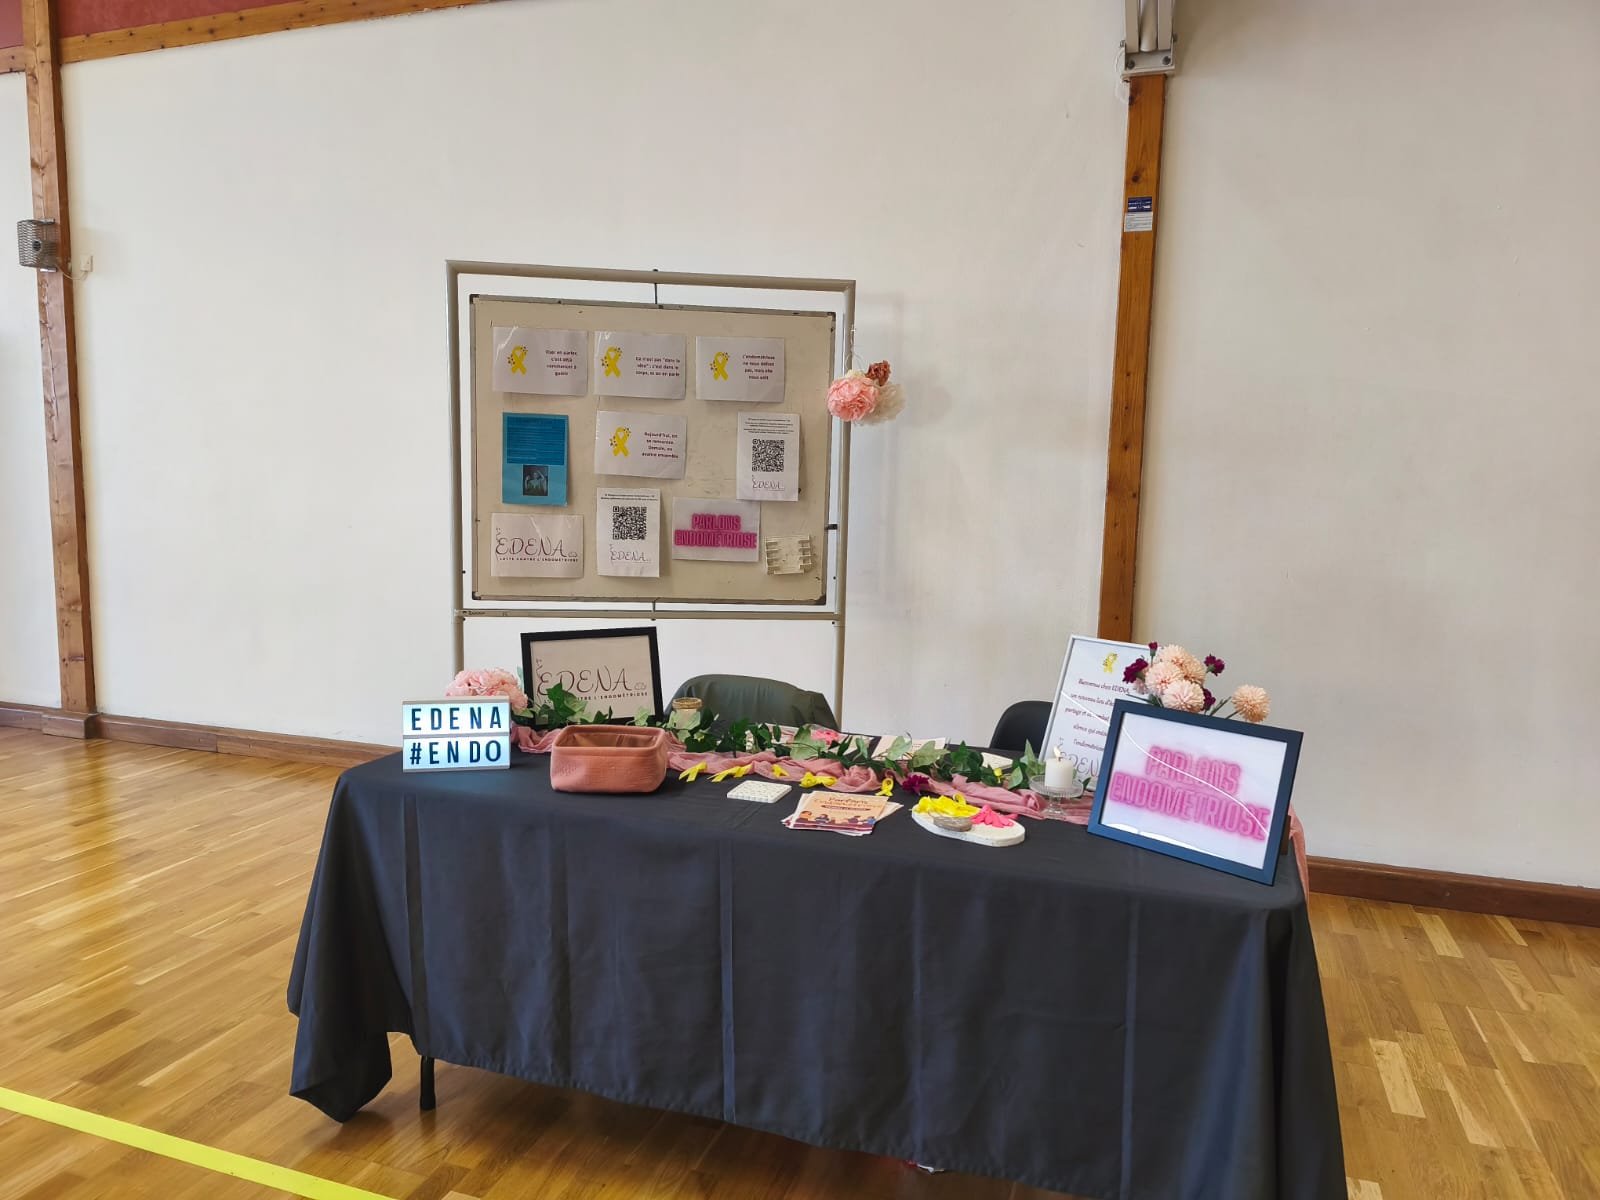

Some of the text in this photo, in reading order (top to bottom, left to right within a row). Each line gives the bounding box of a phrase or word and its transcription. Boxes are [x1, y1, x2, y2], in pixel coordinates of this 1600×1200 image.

[692, 513, 741, 531] PARLONS
[495, 536, 567, 557] EDENA
[536, 665, 633, 697] EDENA
[410, 706, 502, 731] EDENA
[409, 740, 502, 765] #ENDO
[1146, 747, 1241, 795] PARLONS
